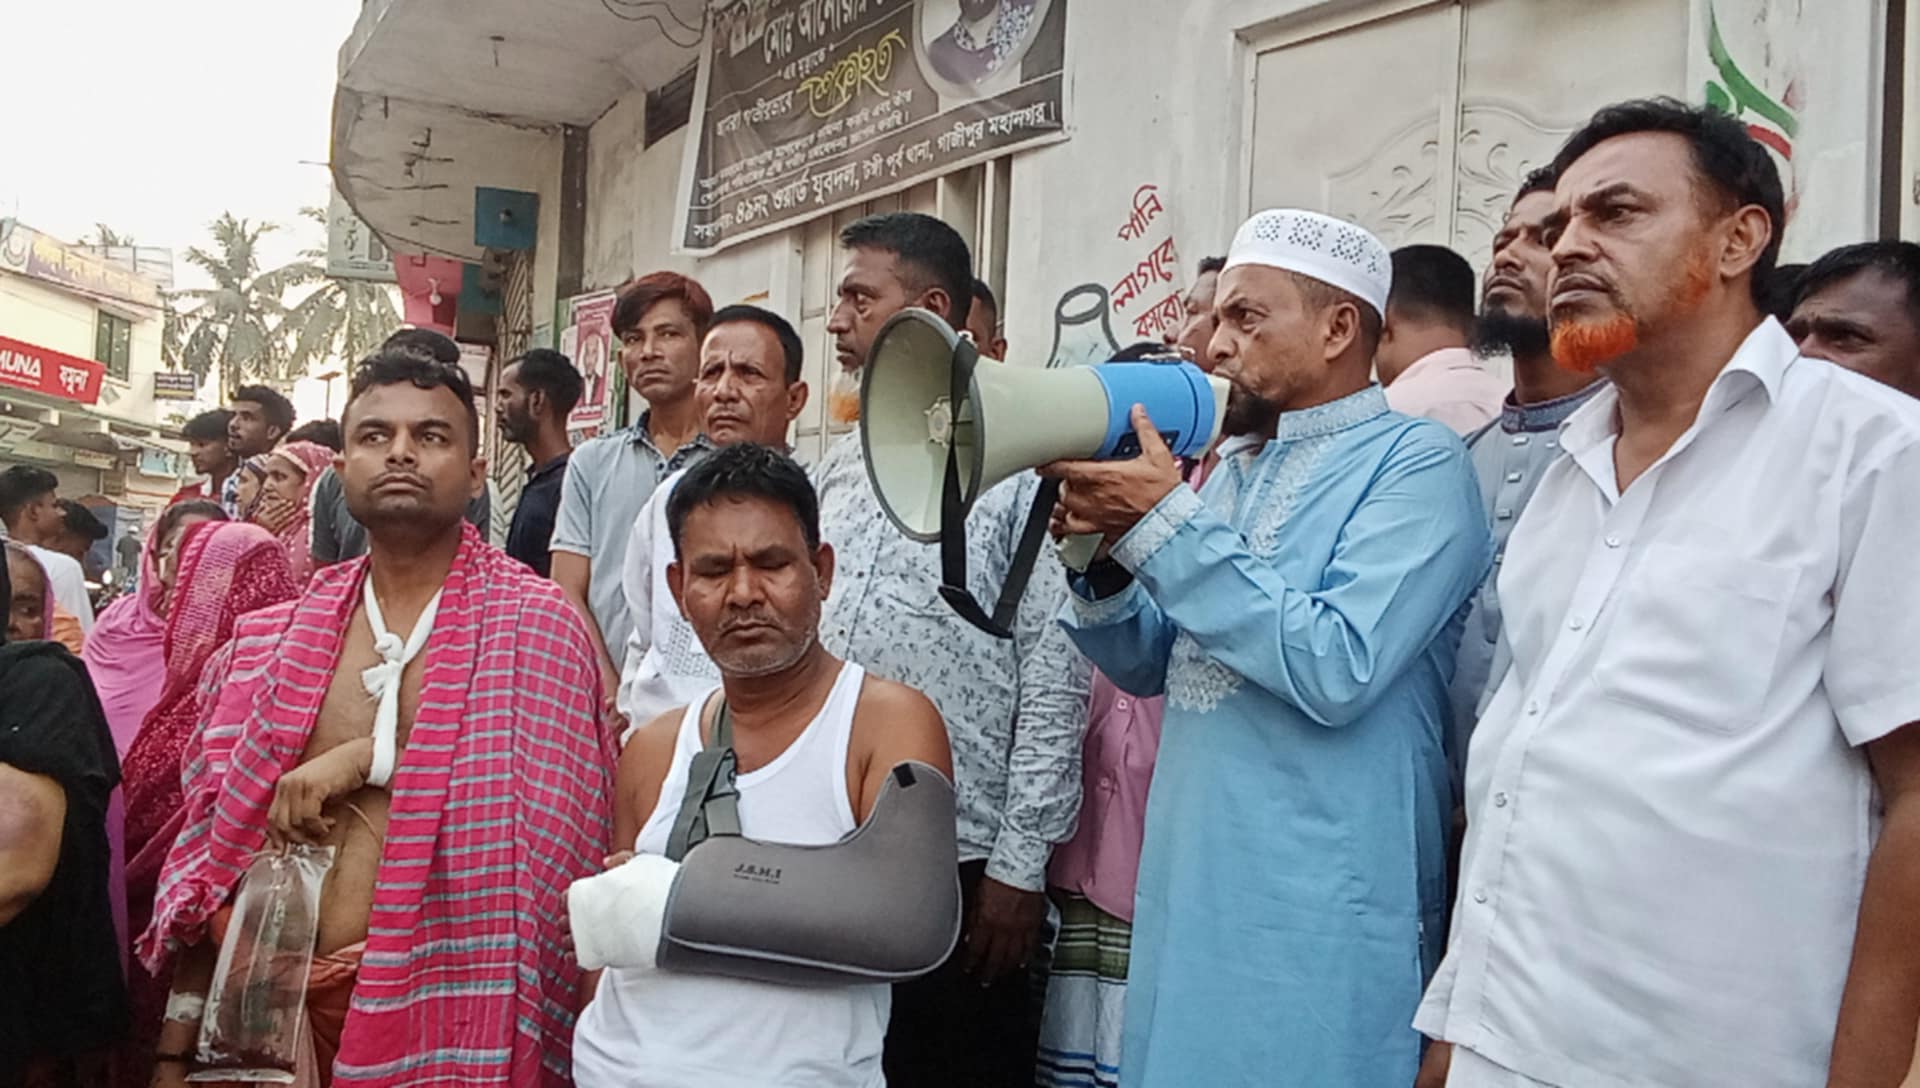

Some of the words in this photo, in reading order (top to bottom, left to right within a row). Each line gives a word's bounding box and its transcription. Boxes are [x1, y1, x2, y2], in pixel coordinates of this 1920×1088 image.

[938, 120, 985, 152] গাজীপুর
[1117, 184, 1164, 241] পানি
[1110, 235, 1175, 313] লাগবে
